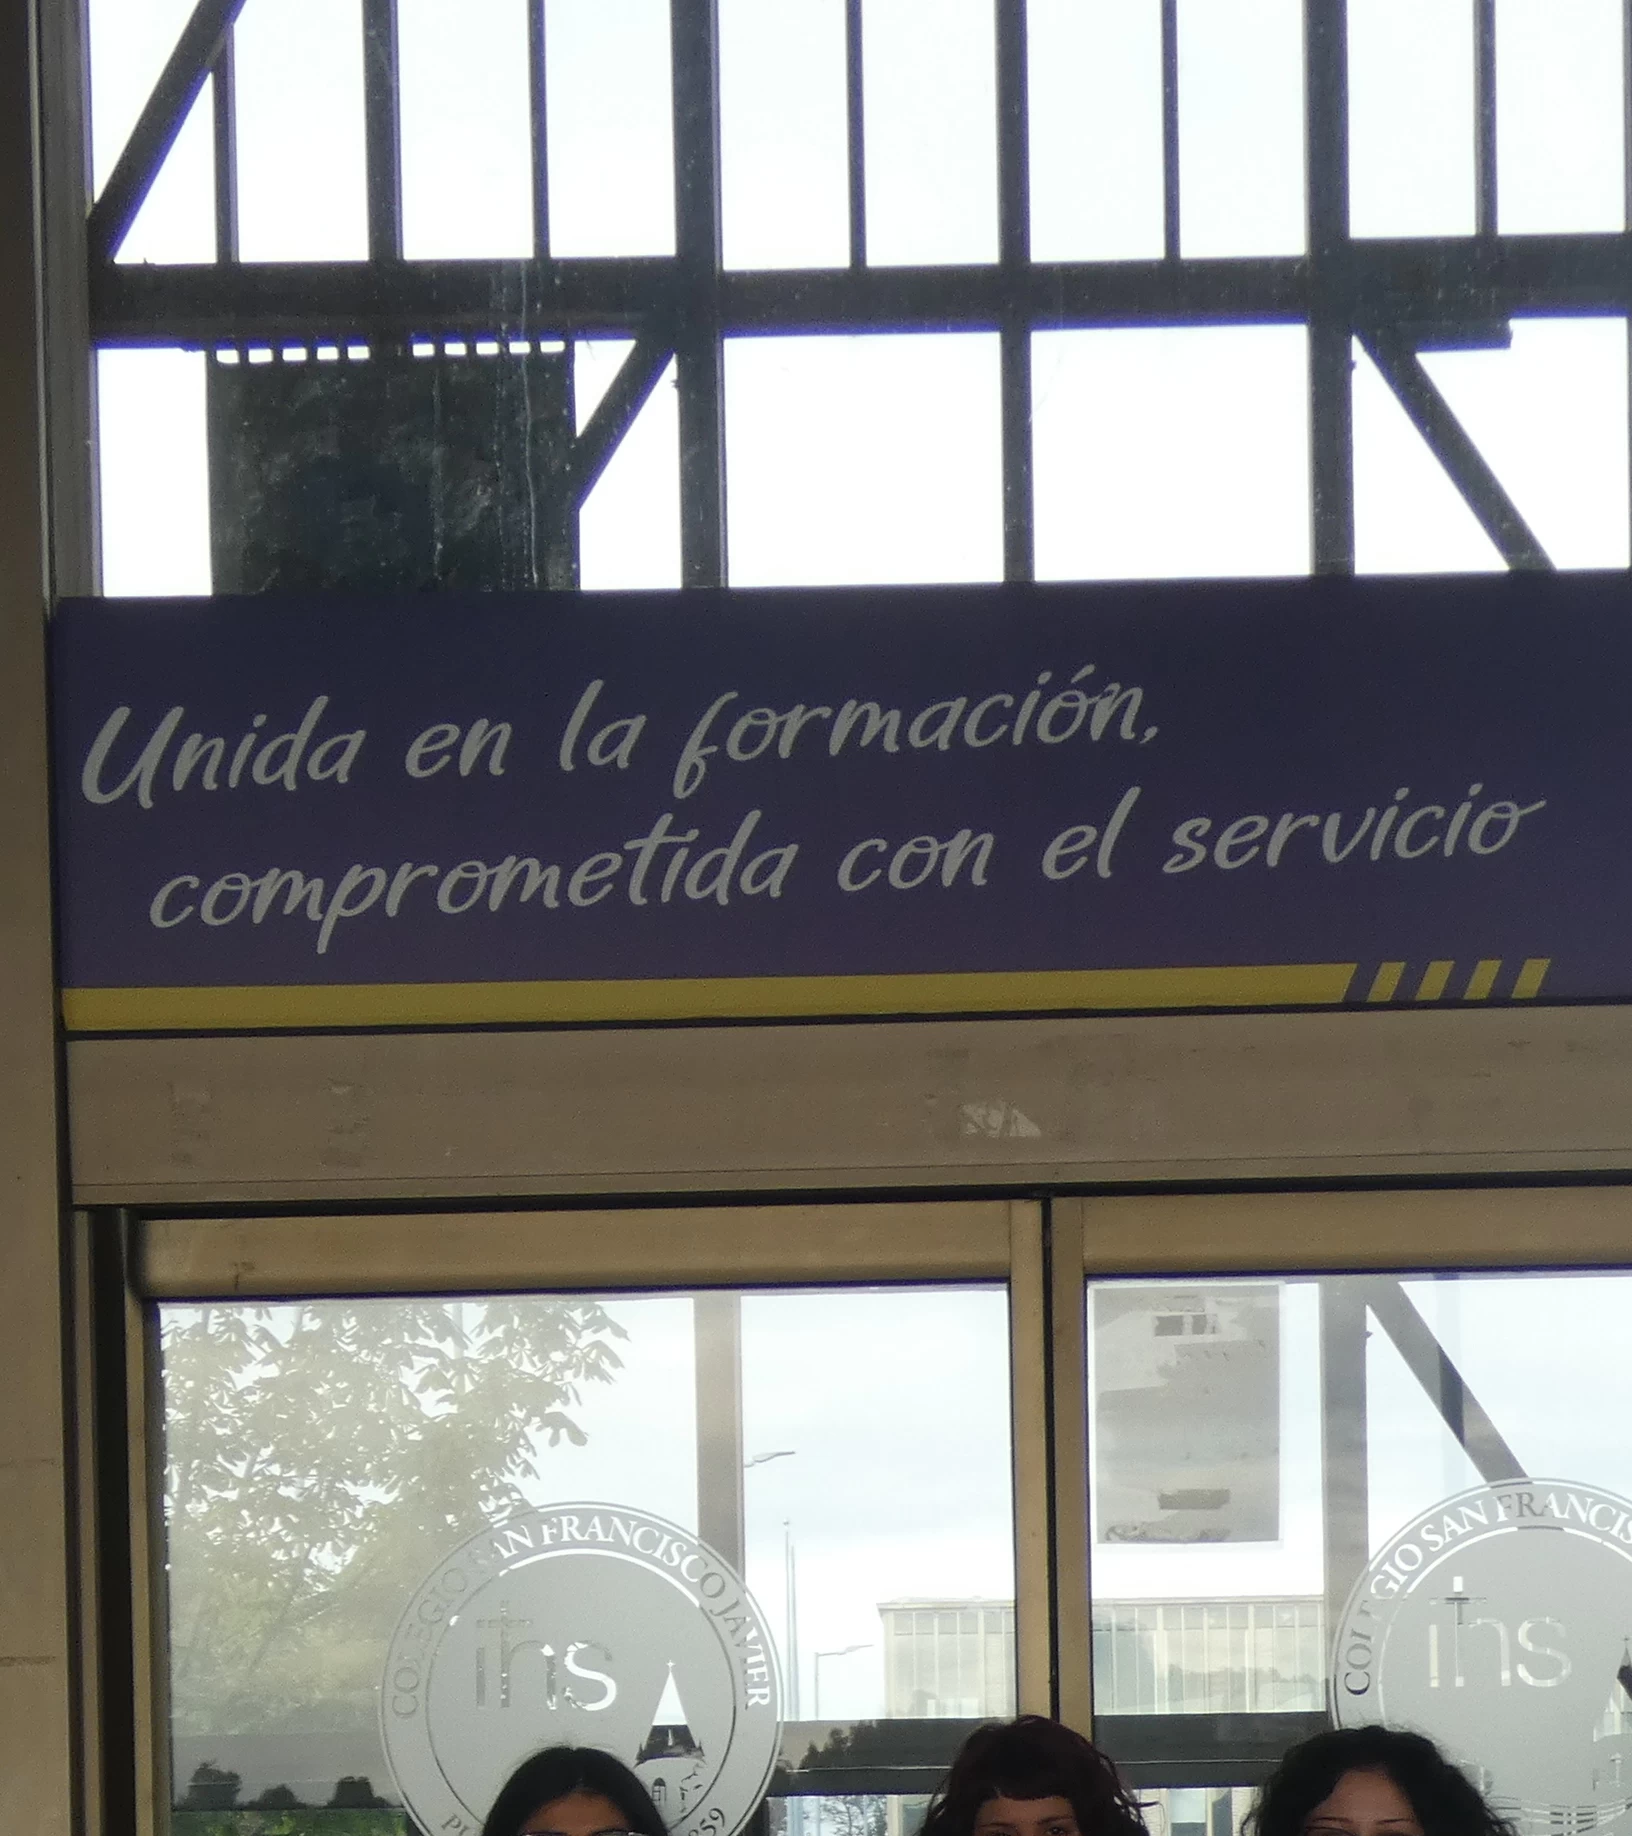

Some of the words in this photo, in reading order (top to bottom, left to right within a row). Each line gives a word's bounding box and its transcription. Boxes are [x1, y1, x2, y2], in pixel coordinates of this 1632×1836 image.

[81, 695, 367, 810] Unida
[404, 717, 515, 779] en
[558, 679, 647, 772] la
[672, 663, 1160, 800] formación,
[149, 810, 798, 955] comprometida
[837, 826, 996, 893] con
[1041, 786, 1142, 881] el
[1162, 783, 1547, 874] servicio
[1423, 1499, 1488, 1552] SAN
[391, 1565, 470, 1719] COLEGIO
[542, 1513, 726, 1601] FRANCISCO
[709, 1597, 771, 1710] JAVIER
